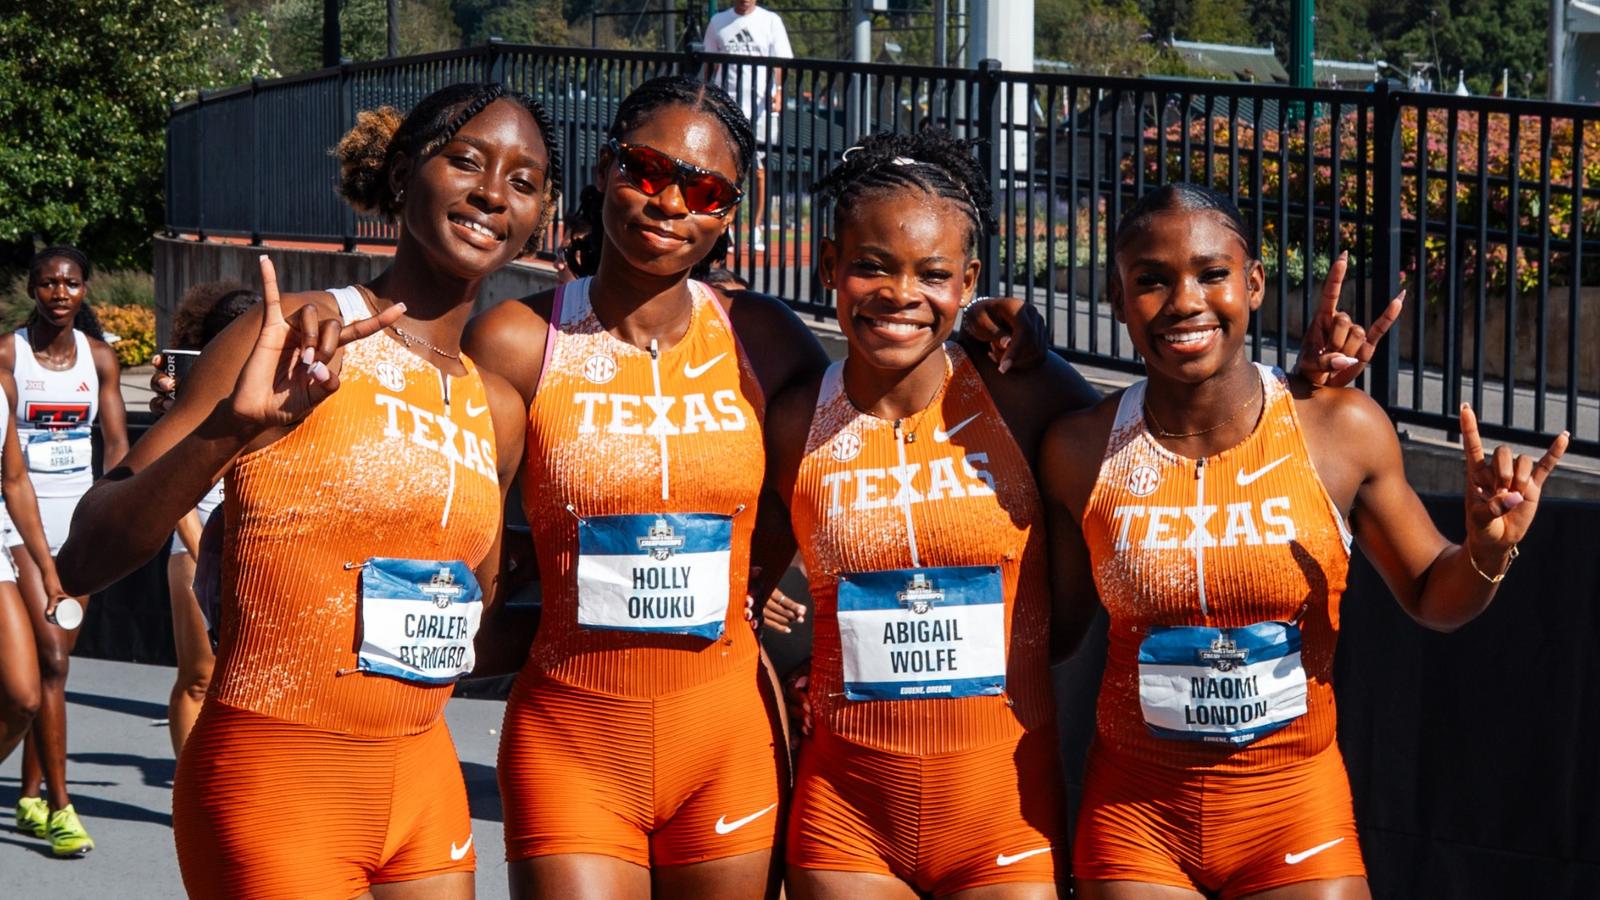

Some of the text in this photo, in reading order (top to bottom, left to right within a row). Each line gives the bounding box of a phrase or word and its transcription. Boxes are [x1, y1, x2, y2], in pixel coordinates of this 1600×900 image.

[585, 355, 615, 383] SEC
[574, 390, 747, 435] TEXAS
[375, 393, 498, 485] TEXAS
[832, 433, 861, 461] SEC
[822, 452, 996, 517] TEXAS
[1128, 466, 1159, 496] SEC
[1113, 496, 1296, 551] TEXAS
[632, 566, 691, 590] HOLLY
[628, 596, 695, 619] OKUKU
[404, 613, 468, 639] CARLETA
[883, 619, 963, 644] ABIGAIL
[400, 645, 466, 669] BERNARD
[890, 649, 958, 674] WOLFE
[1191, 675, 1260, 699] NAOMI
[1185, 701, 1267, 726] LONDON
